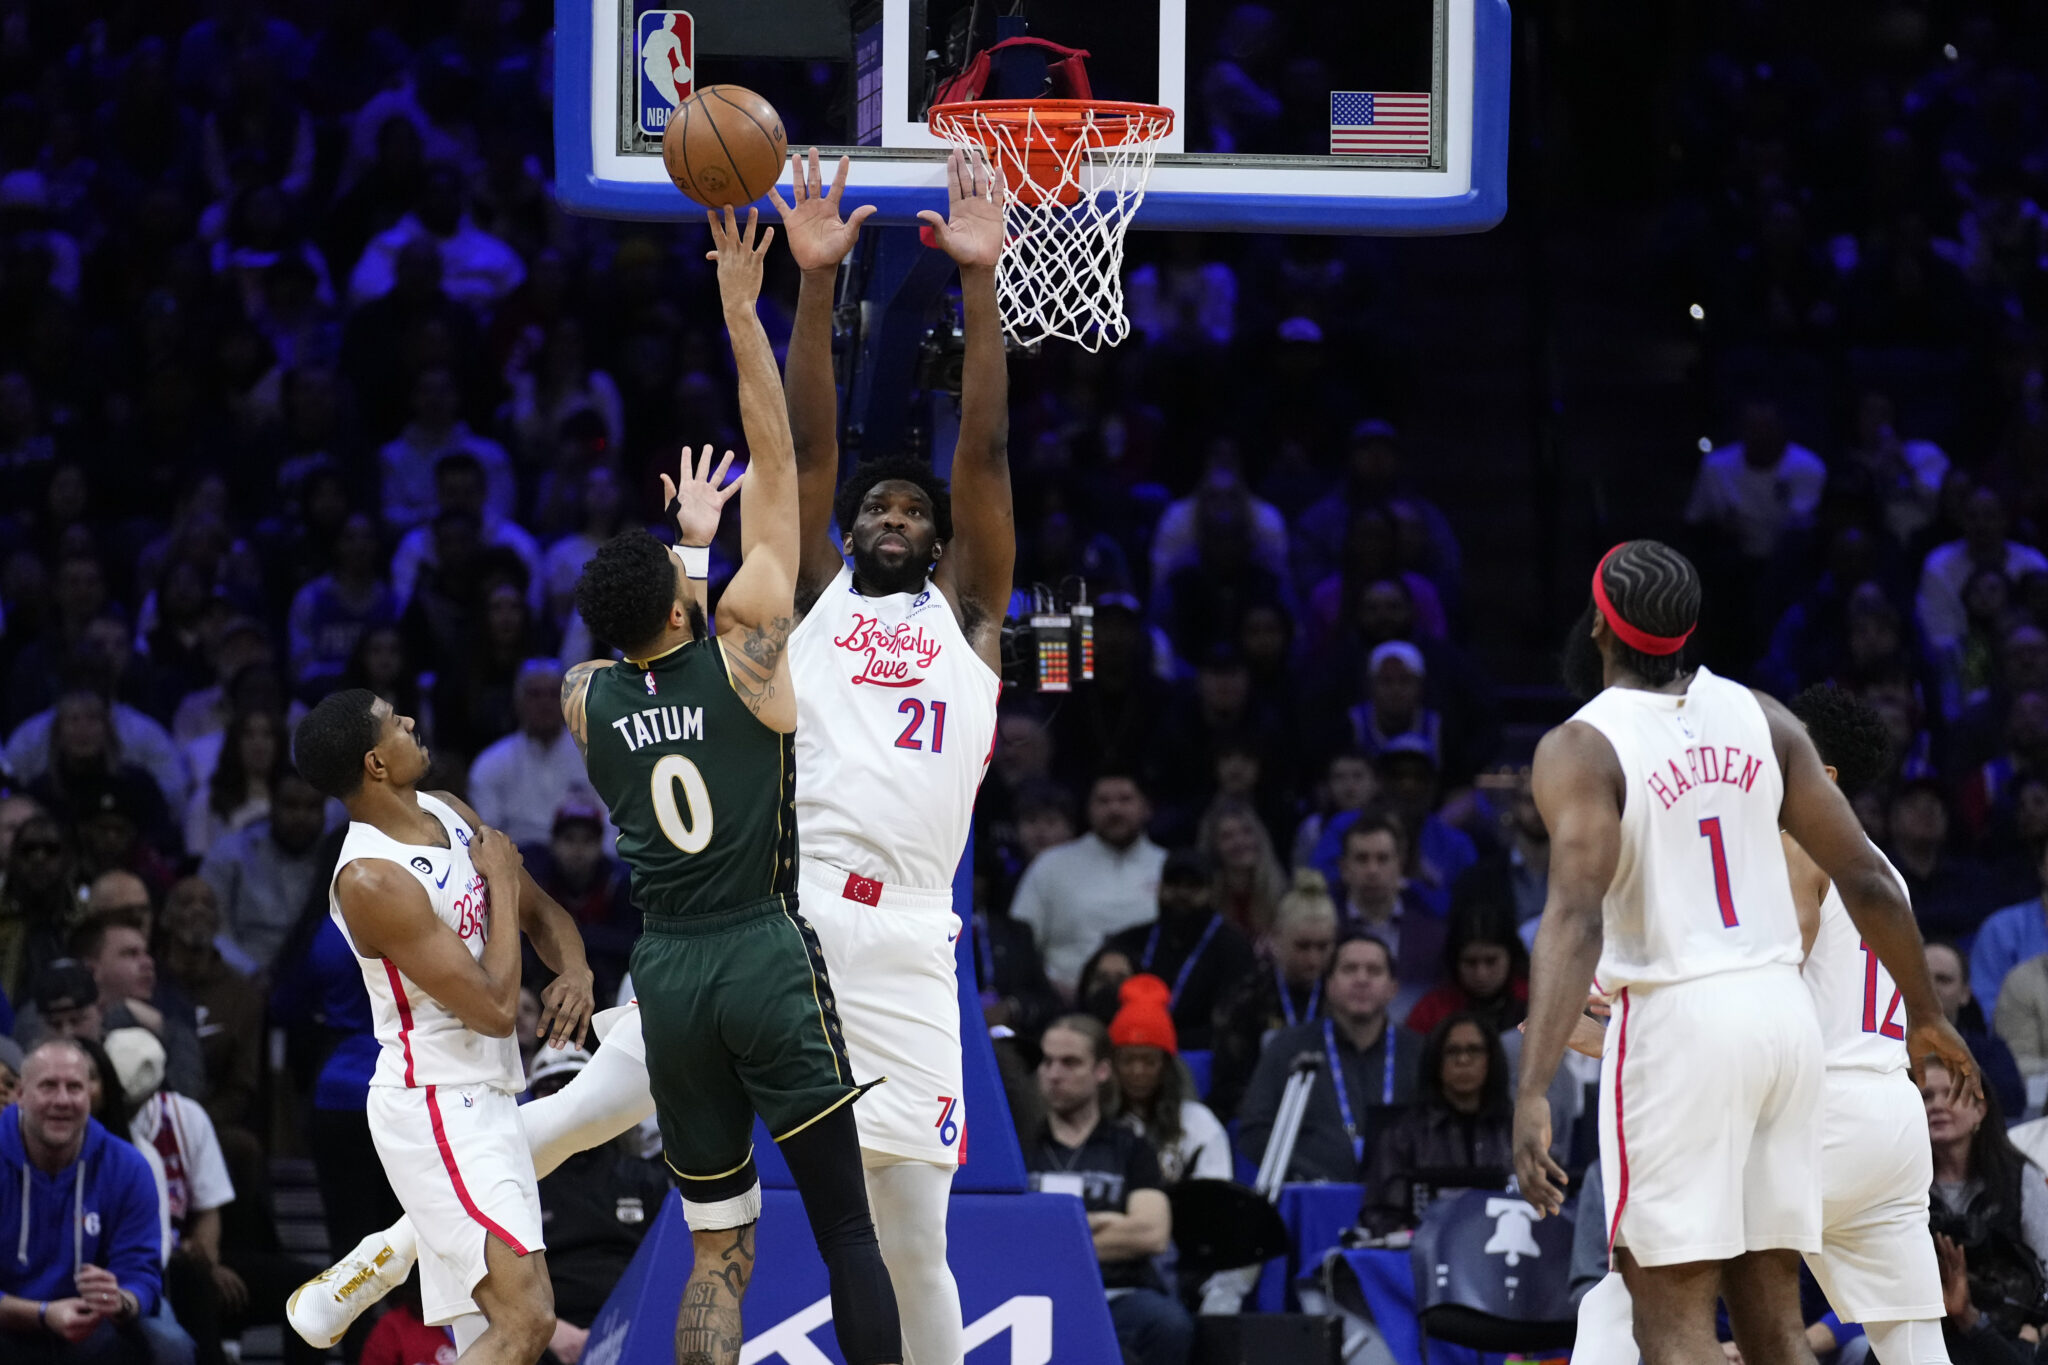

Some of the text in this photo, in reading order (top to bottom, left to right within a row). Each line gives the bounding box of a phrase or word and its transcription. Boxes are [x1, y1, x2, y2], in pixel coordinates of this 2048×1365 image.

[834, 613, 942, 668] Brotherly
[851, 647, 925, 687] Love
[612, 706, 704, 751] TATUM
[894, 697, 947, 753] 21
[650, 754, 714, 854] 0
[1648, 746, 1762, 810] HARDEN
[1698, 816, 1740, 929] 1
[935, 1096, 957, 1146] 76
